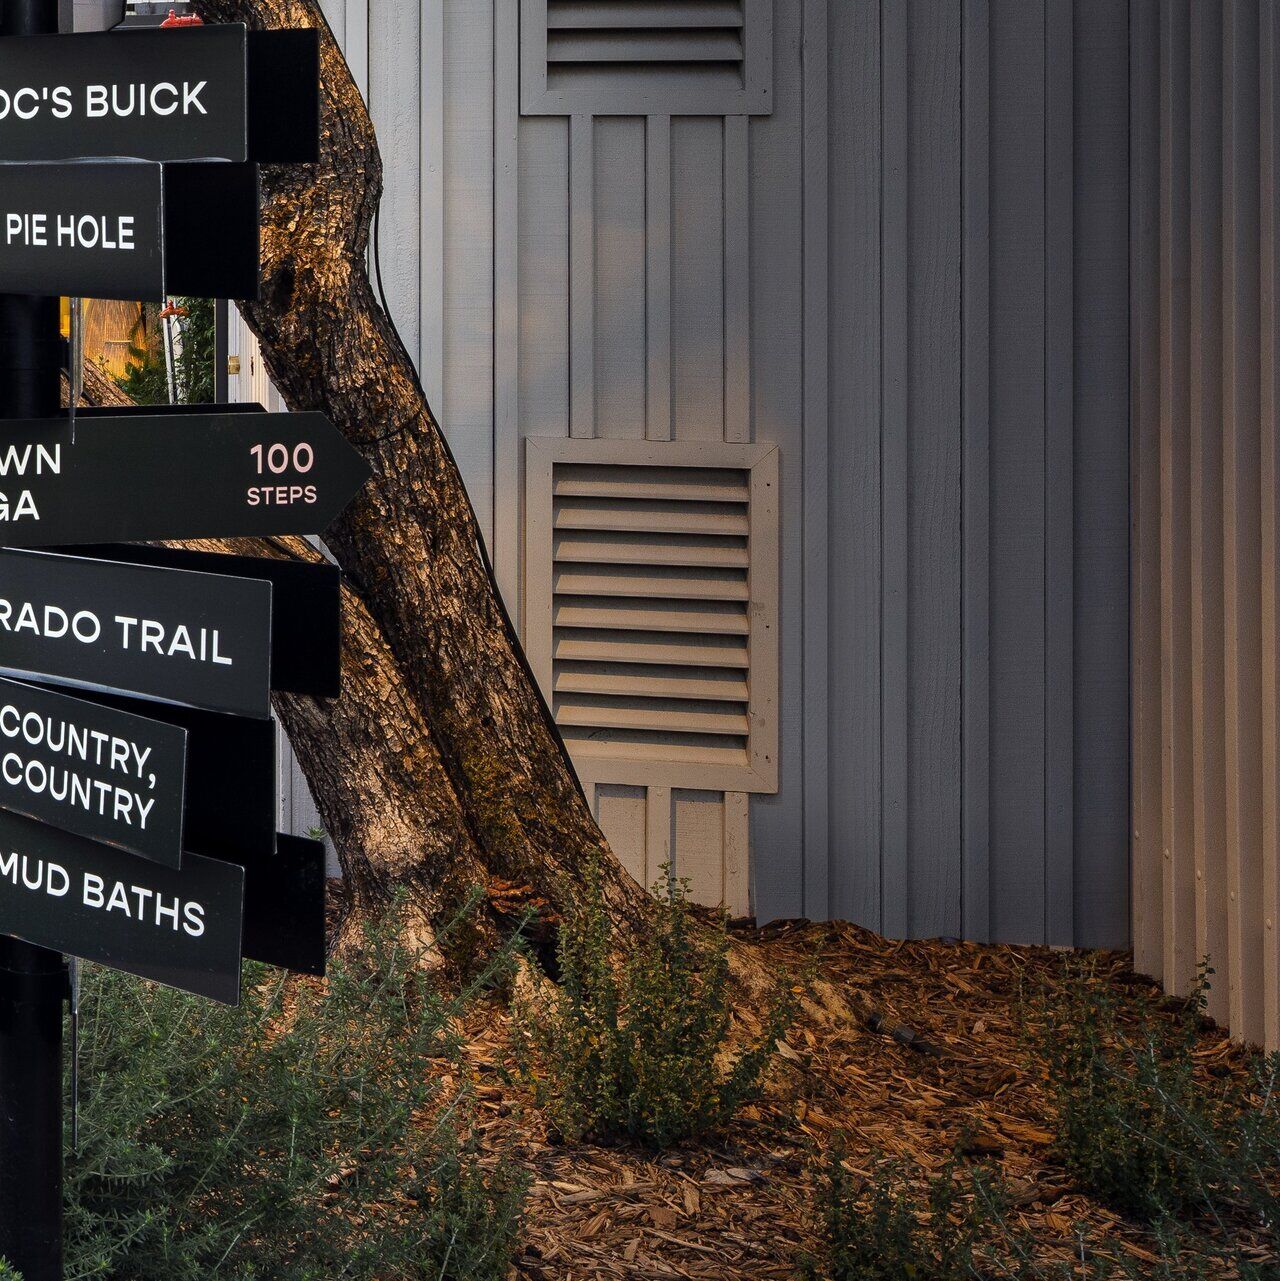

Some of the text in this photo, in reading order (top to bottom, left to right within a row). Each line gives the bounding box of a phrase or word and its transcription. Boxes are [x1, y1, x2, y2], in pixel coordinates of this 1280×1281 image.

[87, 81, 207, 117] BUICK
[7, 214, 134, 249] PIE HOLE
[251, 443, 313, 473] 100
[247, 486, 316, 505] STEPS
[115, 616, 232, 664] TRAIL
[0, 705, 155, 789] COUNTRY,
[3, 753, 155, 829] COUNTRY
[83, 873, 204, 936] BATHS
